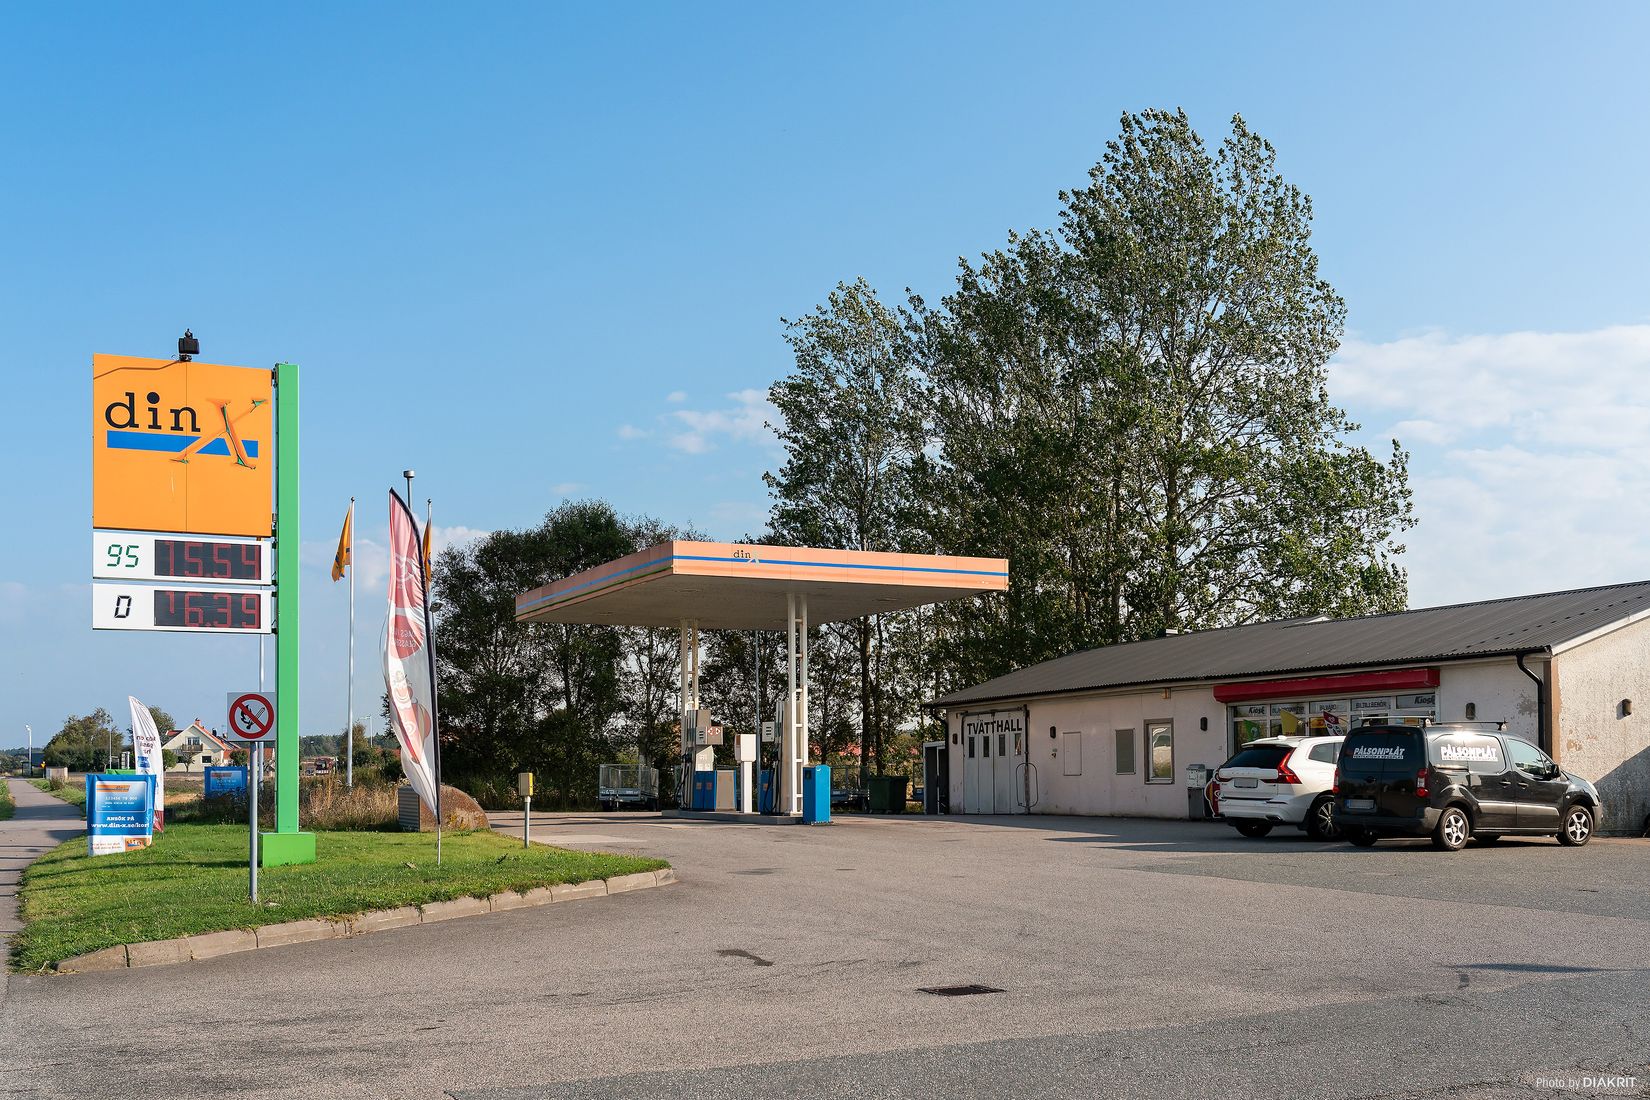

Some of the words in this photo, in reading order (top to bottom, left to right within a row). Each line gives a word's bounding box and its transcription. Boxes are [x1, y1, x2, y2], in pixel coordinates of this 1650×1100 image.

[104, 391, 201, 433] din
[107, 543, 140, 568] 95
[733, 549, 751, 559] din
[966, 718, 1023, 735] TVÄTTHALL
[1353, 745, 1406, 756] PÅLSONPLÅT
[1440, 743, 1497, 758] PÅLSONPLÅT
